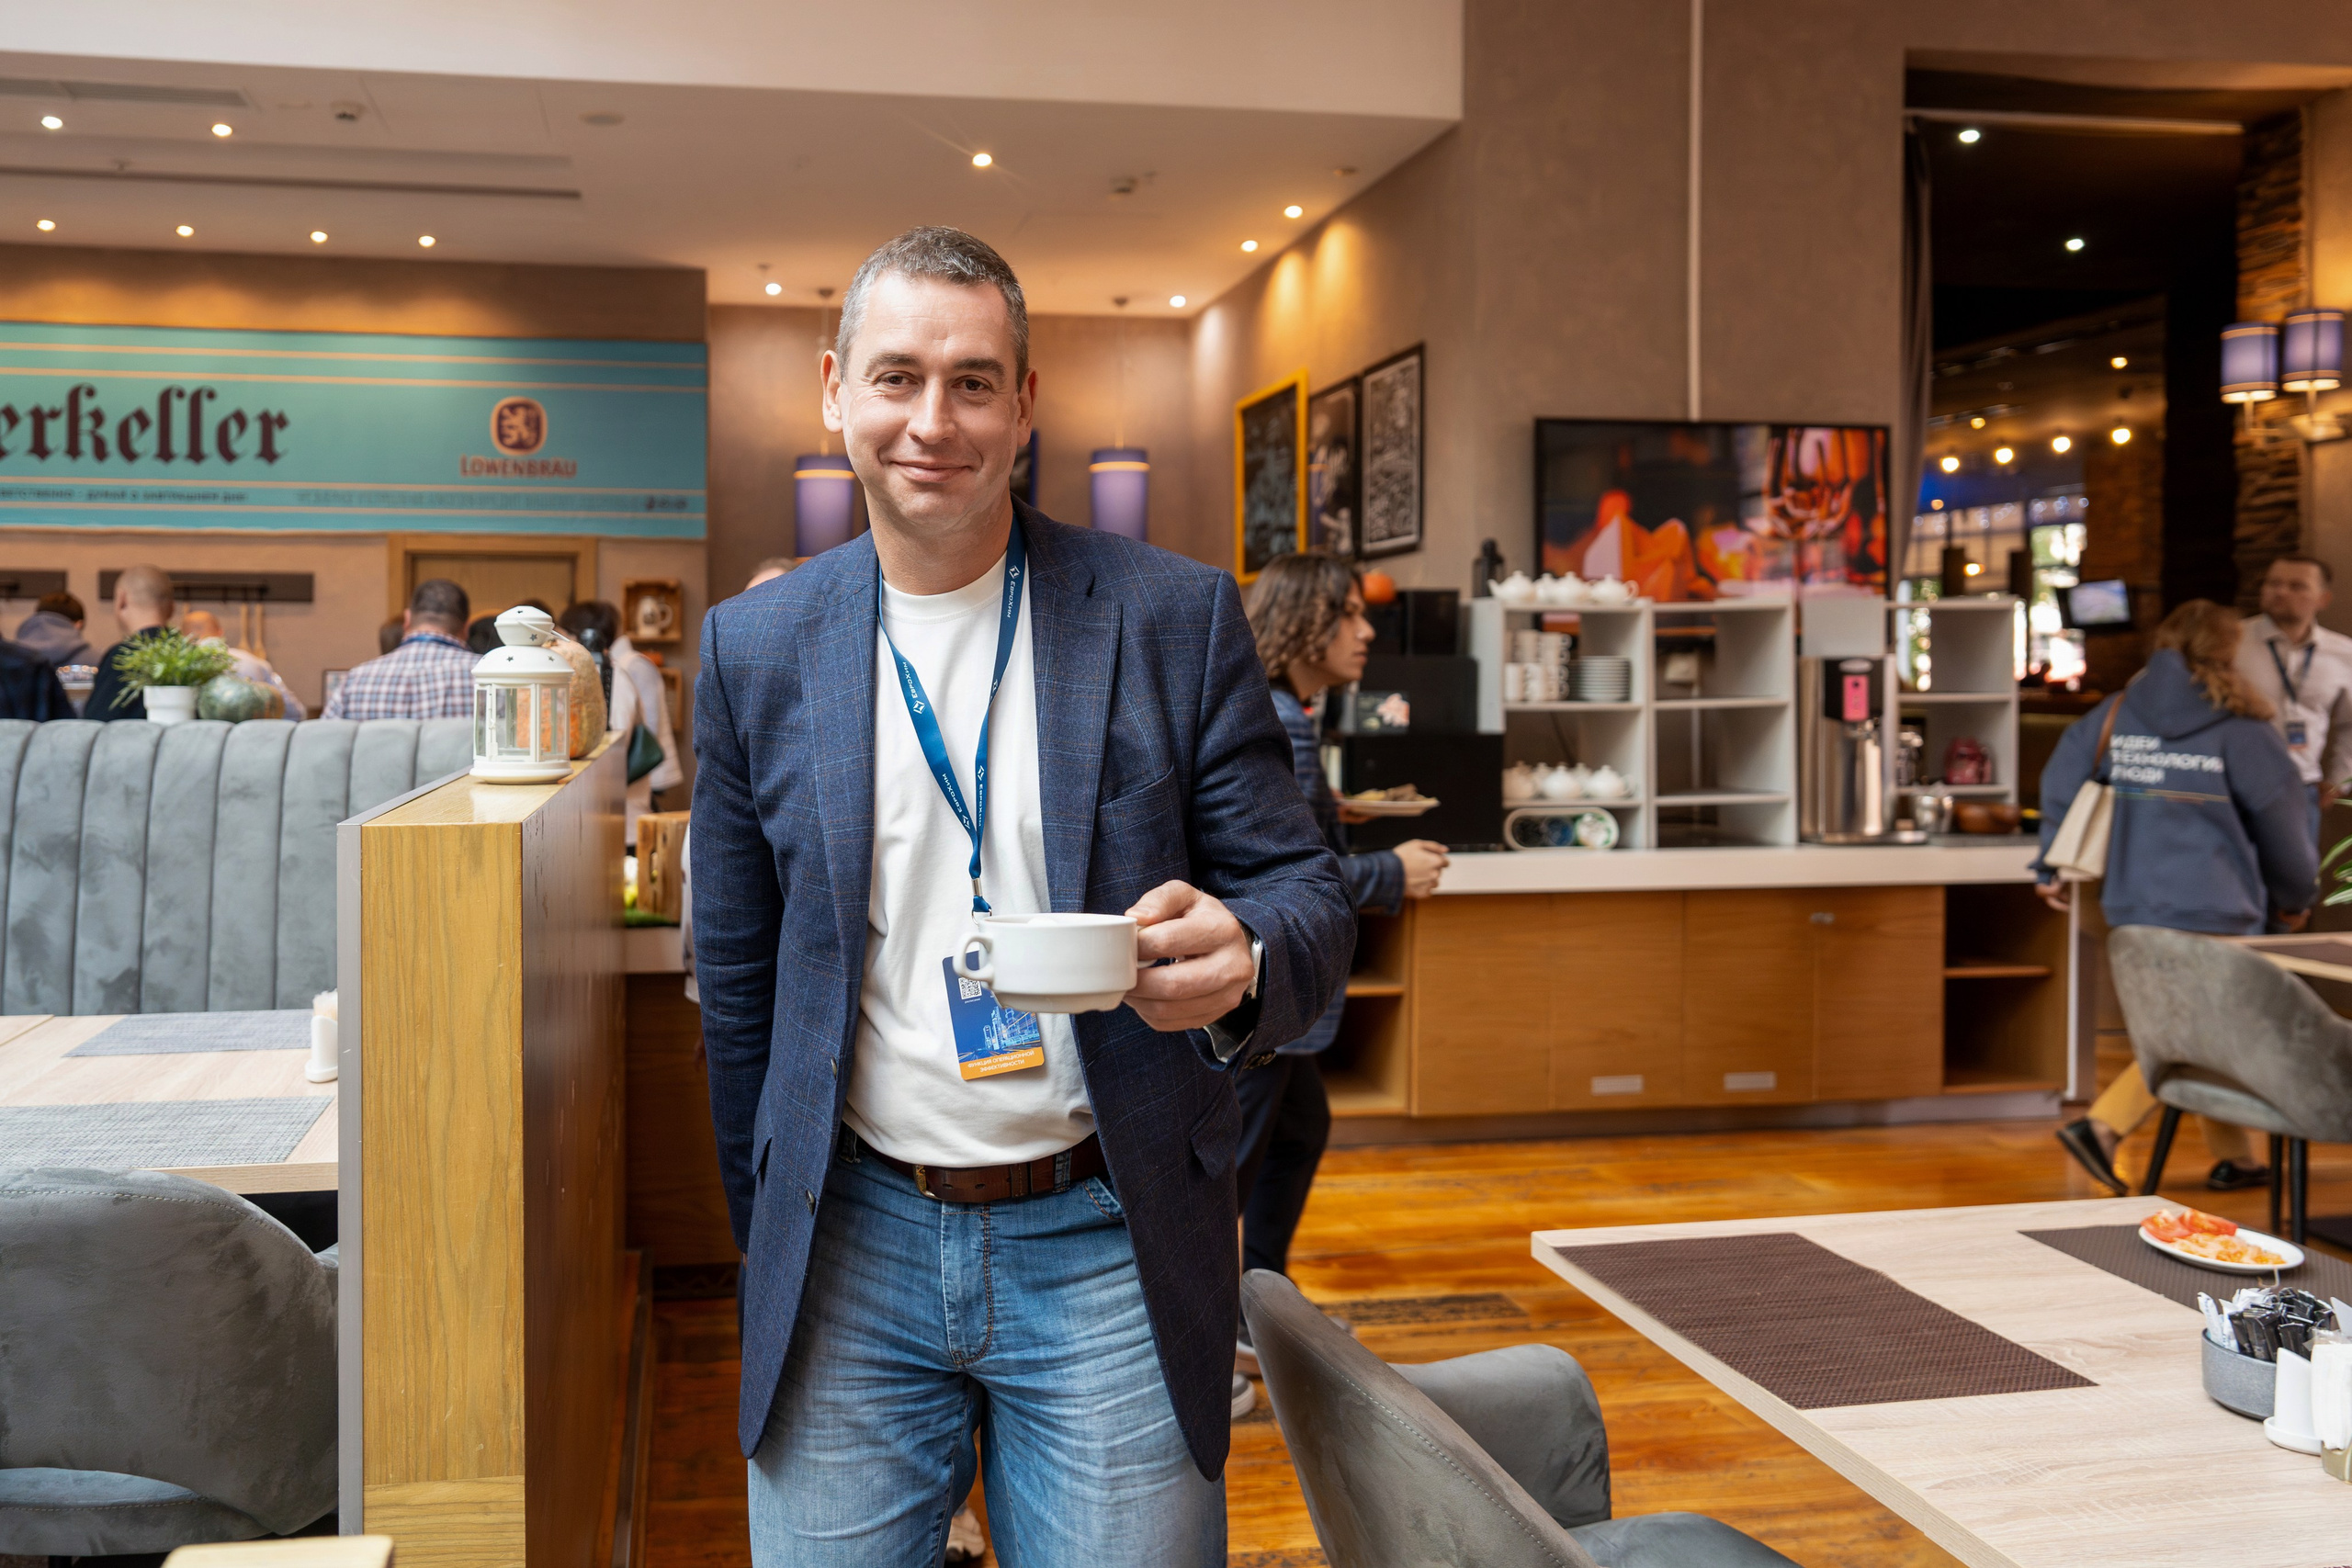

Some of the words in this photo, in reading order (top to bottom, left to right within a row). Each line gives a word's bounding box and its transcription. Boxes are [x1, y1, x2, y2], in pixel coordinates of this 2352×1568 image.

[967, 1058, 992, 1068] ФУНКЦИЯ
[992, 1050, 1035, 1064] ОПЕРАЦИОННОЙ
[979, 1059, 1024, 1072] ЭФФЕКТИВНОСТИ
